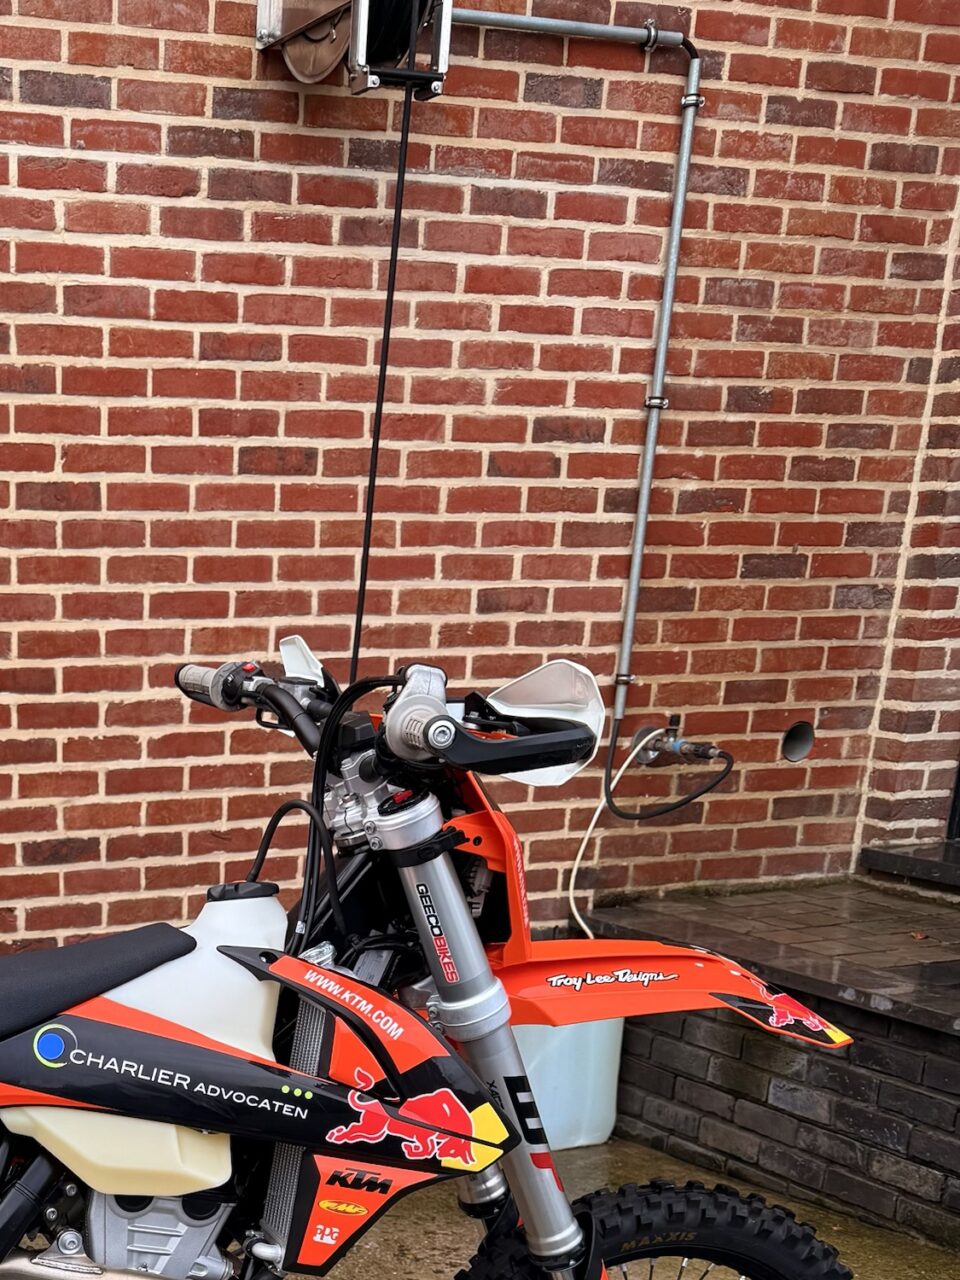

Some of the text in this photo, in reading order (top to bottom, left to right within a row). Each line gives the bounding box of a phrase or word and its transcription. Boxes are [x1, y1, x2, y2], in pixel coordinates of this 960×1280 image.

[416, 883, 460, 984] GEECOBIKES
[303, 968, 405, 1041] WWW.KTM.COM
[547, 973, 583, 992] Troy
[585, 972, 616, 985] Lee
[69, 1049, 309, 1120] CHARLIER ADVOCATEN
[325, 1167, 394, 1195] KTM
[621, 1231, 697, 1252] MAXXIS
